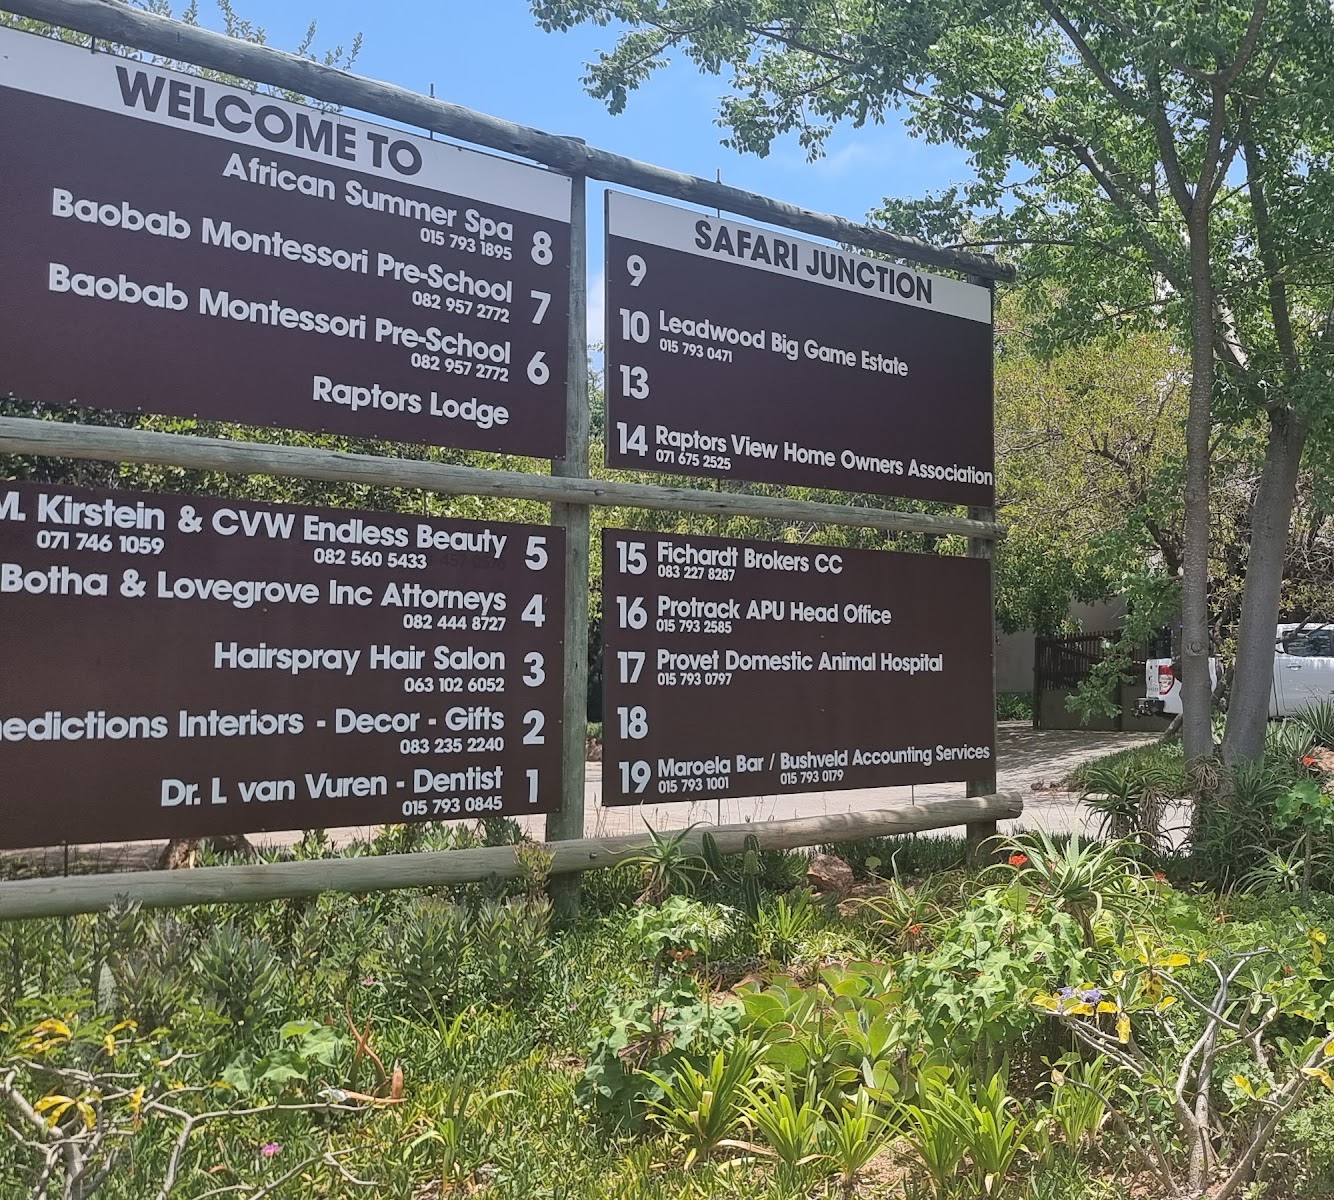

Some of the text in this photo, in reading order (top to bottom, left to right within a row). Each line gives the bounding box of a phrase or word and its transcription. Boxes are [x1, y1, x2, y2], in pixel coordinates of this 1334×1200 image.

[115, 65, 423, 176] WELCOME TO
[221, 152, 513, 242] African Summer Spa
[52, 187, 513, 304] Baobab Montessori Pre-School
[420, 227, 513, 261] 015 793 1895
[530, 230, 553, 266] 8
[626, 254, 647, 287] 9
[694, 219, 932, 305] SAFARI JUNCTION
[48, 262, 511, 365] Baobab Montessori Pre-School
[412, 290, 510, 324] 082 957 2772
[530, 289, 552, 325] 7
[619, 307, 650, 344] 10
[659, 309, 909, 377] Leadwood Big Game Estate
[659, 337, 733, 363] 015 793 0471
[410, 352, 509, 383] 082 957 2772
[526, 350, 550, 386] 6
[619, 364, 650, 400] 13
[312, 375, 510, 431] Raptors Lodge
[616, 421, 649, 457] 14
[655, 424, 993, 486] Raptors View Home Owners Association
[655, 448, 732, 471] 071 675 2525
[36, 529, 165, 555] 071 746 1059
[37, 493, 165, 531] Kirstein
[177, 505, 203, 533] &
[211, 508, 296, 539] CVW
[303, 514, 409, 548] Endless
[416, 524, 508, 559] Beauty
[313, 547, 346, 565] 082
[350, 550, 383, 567] 560
[387, 552, 428, 570] 5433
[524, 535, 548, 571] 5
[616, 540, 648, 575] 15
[657, 541, 843, 574] Fichardt Brokers CC
[0, 563, 507, 616] Botha & Lovegrove Inc Attorneys
[657, 564, 736, 582] 083 227 8287
[402, 613, 507, 632] 082 444 8727
[521, 594, 546, 628] 4
[616, 595, 648, 630] 16
[656, 618, 732, 634] 015 793 2585
[657, 595, 892, 625] Protrack APU Head Office
[214, 641, 506, 676] Hairspray Hair Salon
[522, 651, 546, 687] 3
[617, 651, 646, 684] 17
[657, 648, 943, 676] Provet Domestic Animal Hospital
[404, 676, 505, 693] 063 102 6052
[657, 672, 732, 686] 015 793 0797
[0, 706, 505, 741] edictions Interiors - Decor - Gifts
[522, 709, 545, 745] 2
[617, 705, 649, 740] 18
[399, 736, 504, 755] 083 235 2240
[657, 744, 990, 778] Maroela Bar / Bushveld Accounting Services
[160, 765, 504, 807] Dr. L van Vuren - Dentist
[526, 769, 539, 803] 1
[618, 760, 652, 794] 19
[658, 776, 729, 794] 015 793 1001
[780, 768, 844, 785] 015 793 0179
[402, 795, 503, 816] 015 793 0845
